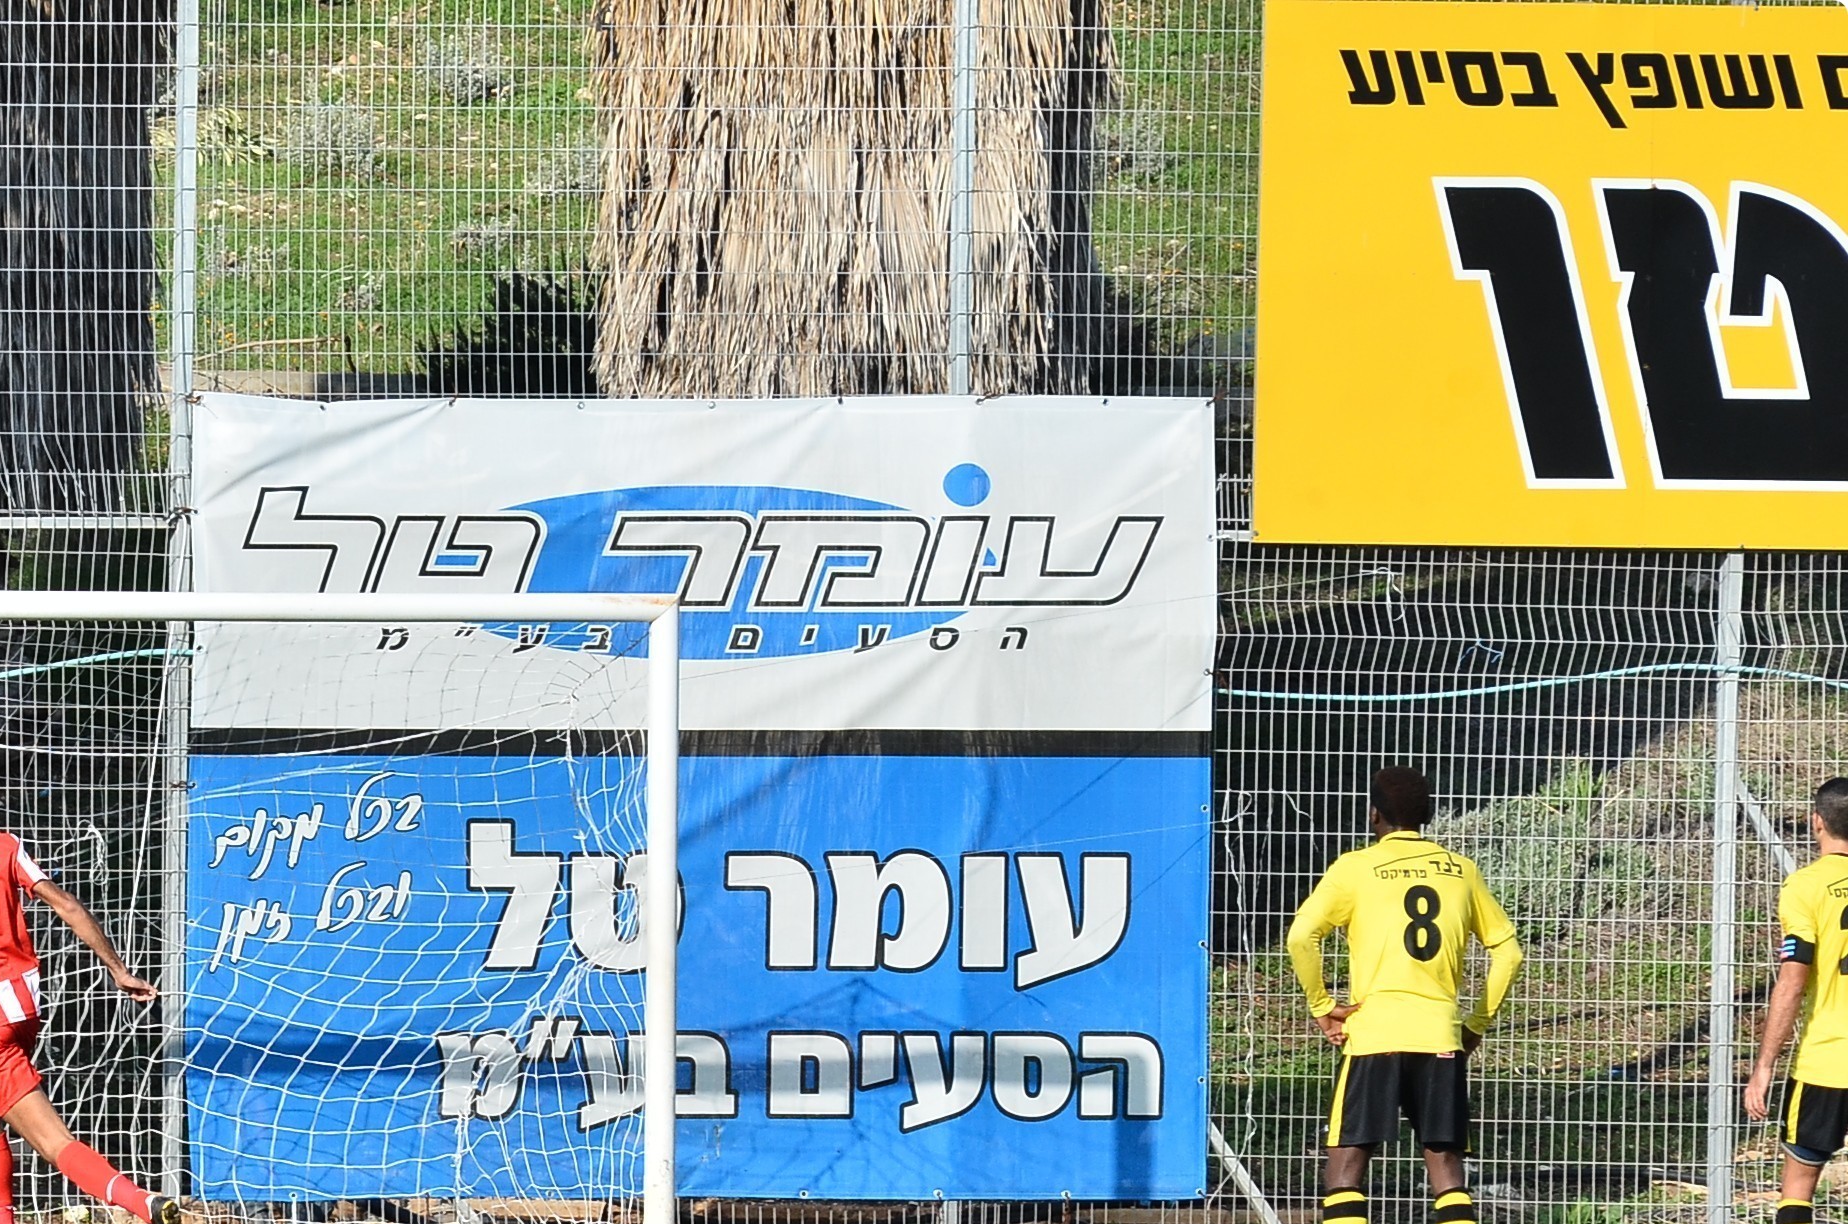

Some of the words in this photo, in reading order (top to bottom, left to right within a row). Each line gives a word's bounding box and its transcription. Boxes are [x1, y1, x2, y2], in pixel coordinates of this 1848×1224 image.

[1338, 49, 1559, 107] בסיוע
[1564, 51, 1805, 129] ושופץ
[608, 461, 1165, 607] עומר
[466, 818, 687, 976] טל
[724, 850, 1131, 990] עומר
[1403, 884, 1443, 963] 8
[765, 1029, 1162, 1134] הסעים
